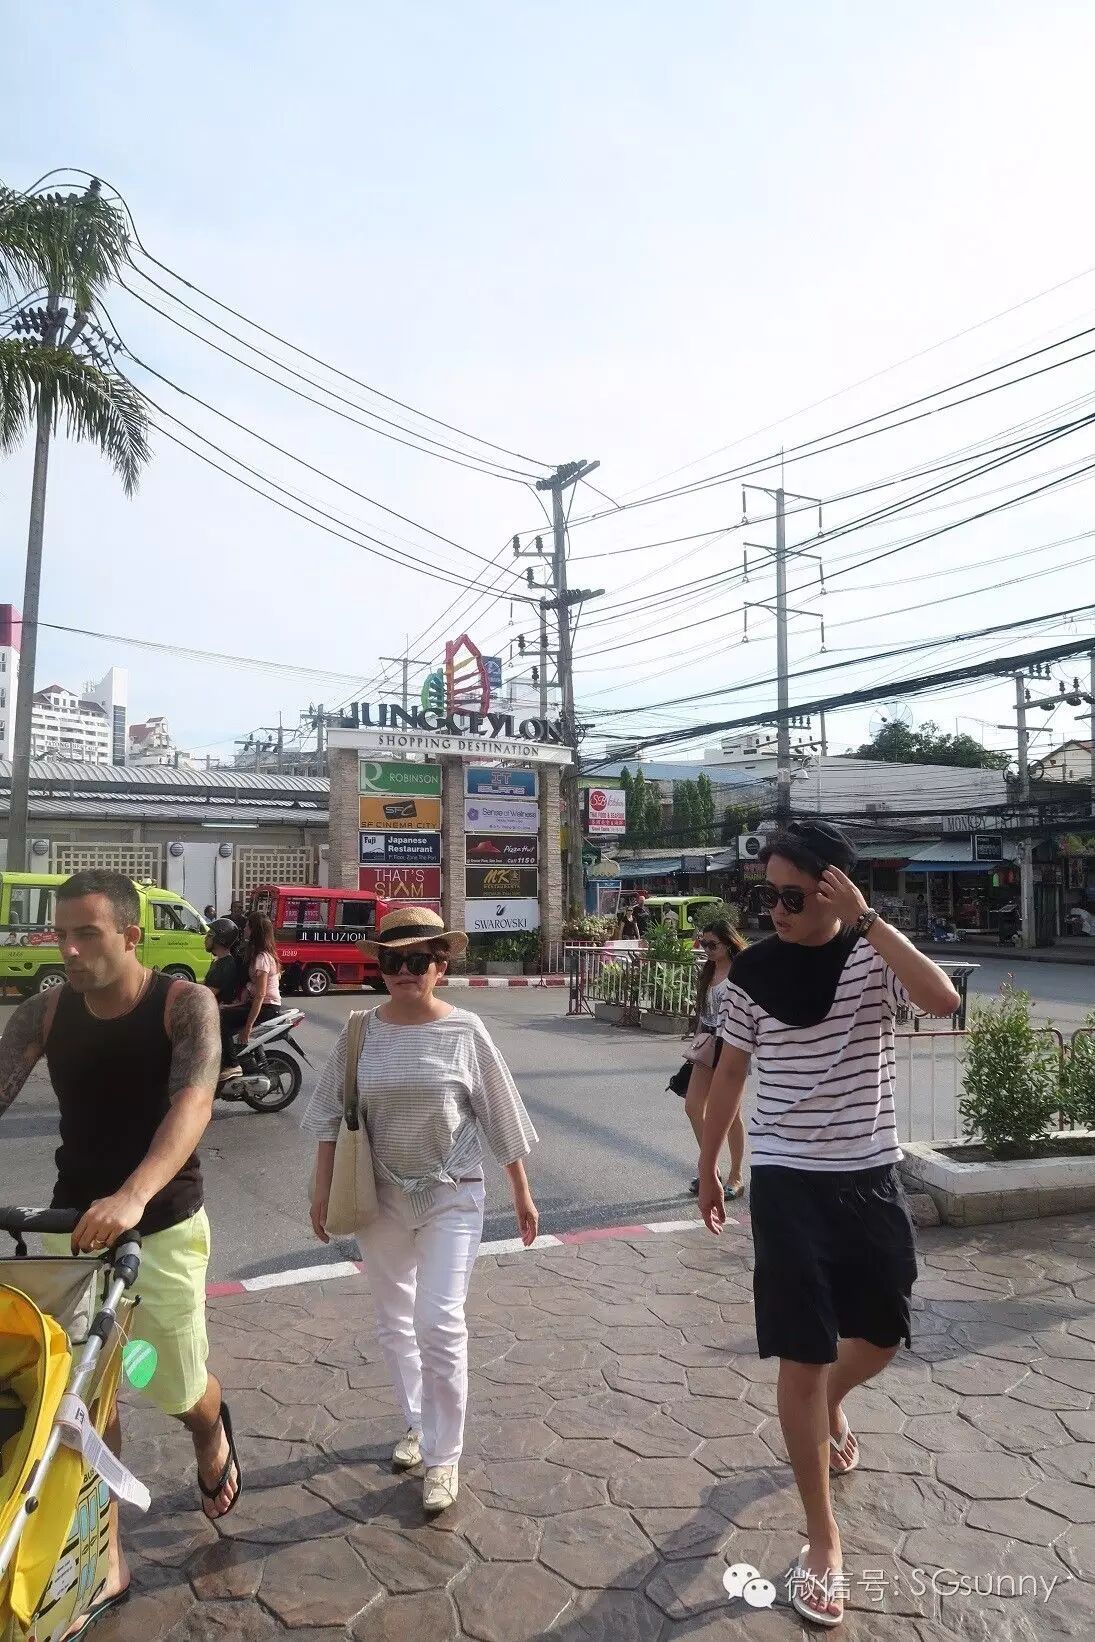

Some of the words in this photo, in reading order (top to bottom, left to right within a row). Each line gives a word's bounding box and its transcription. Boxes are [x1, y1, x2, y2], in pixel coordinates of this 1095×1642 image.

[346, 701, 566, 746] JUNGCEYLON
[378, 734, 451, 750] SHOPPING
[458, 740, 540, 757] DESTINATION
[389, 773, 439, 784] ROBINSON
[482, 807, 503, 816] Sense
[375, 821, 413, 829] CINEMA
[364, 837, 376, 845] Fuji
[388, 836, 428, 844] Japanese
[388, 845, 433, 853] Restaurant
[503, 845, 521, 854] Pizza
[521, 845, 535, 853] Hut
[374, 869, 425, 882] THAT'S
[484, 869, 511, 884] MK
[375, 881, 424, 898] SIAM
[474, 918, 527, 930] SWAROVSKI
[314, 932, 366, 942] ILLUZION
